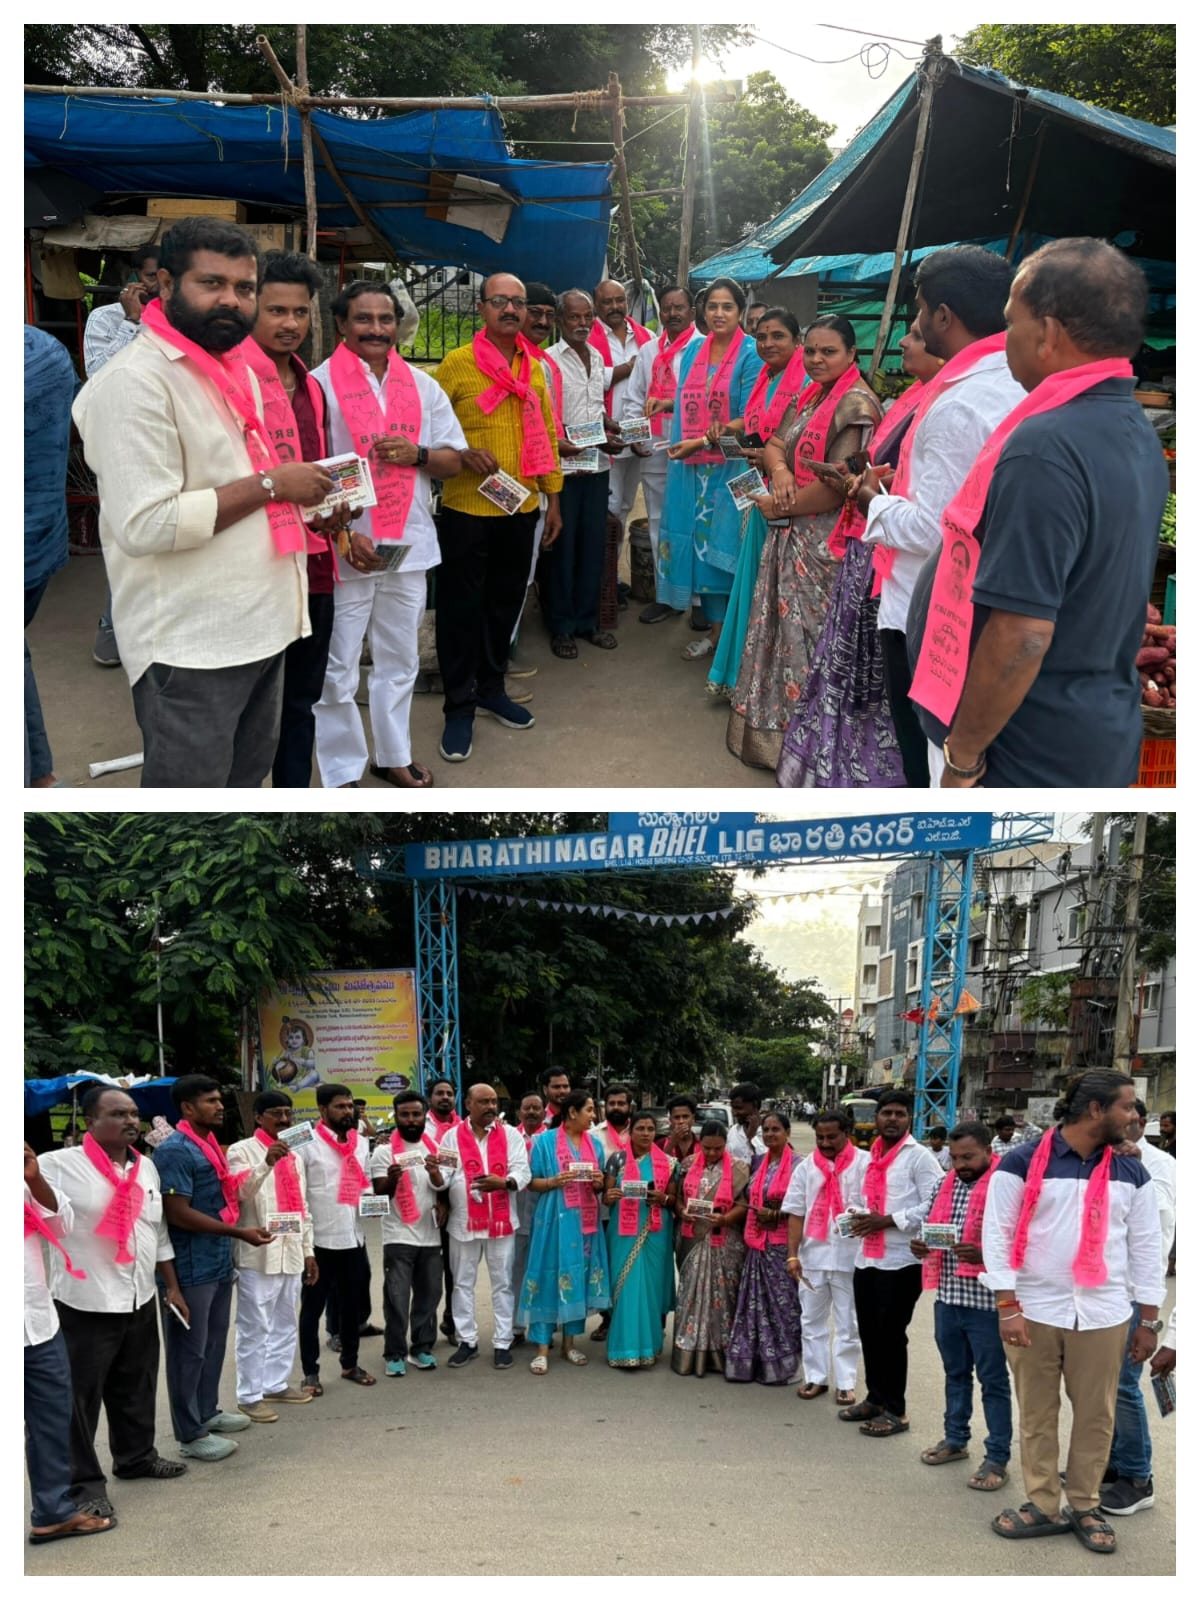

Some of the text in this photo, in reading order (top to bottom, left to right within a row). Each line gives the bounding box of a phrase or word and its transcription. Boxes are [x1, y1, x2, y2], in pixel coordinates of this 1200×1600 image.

[390, 423, 416, 432] BRS
[424, 837, 550, 870] BHARATHI
[554, 833, 645, 863] NAGAR
[648, 825, 709, 857] BHEL
[769, 817, 914, 852] భారతి నగర్
